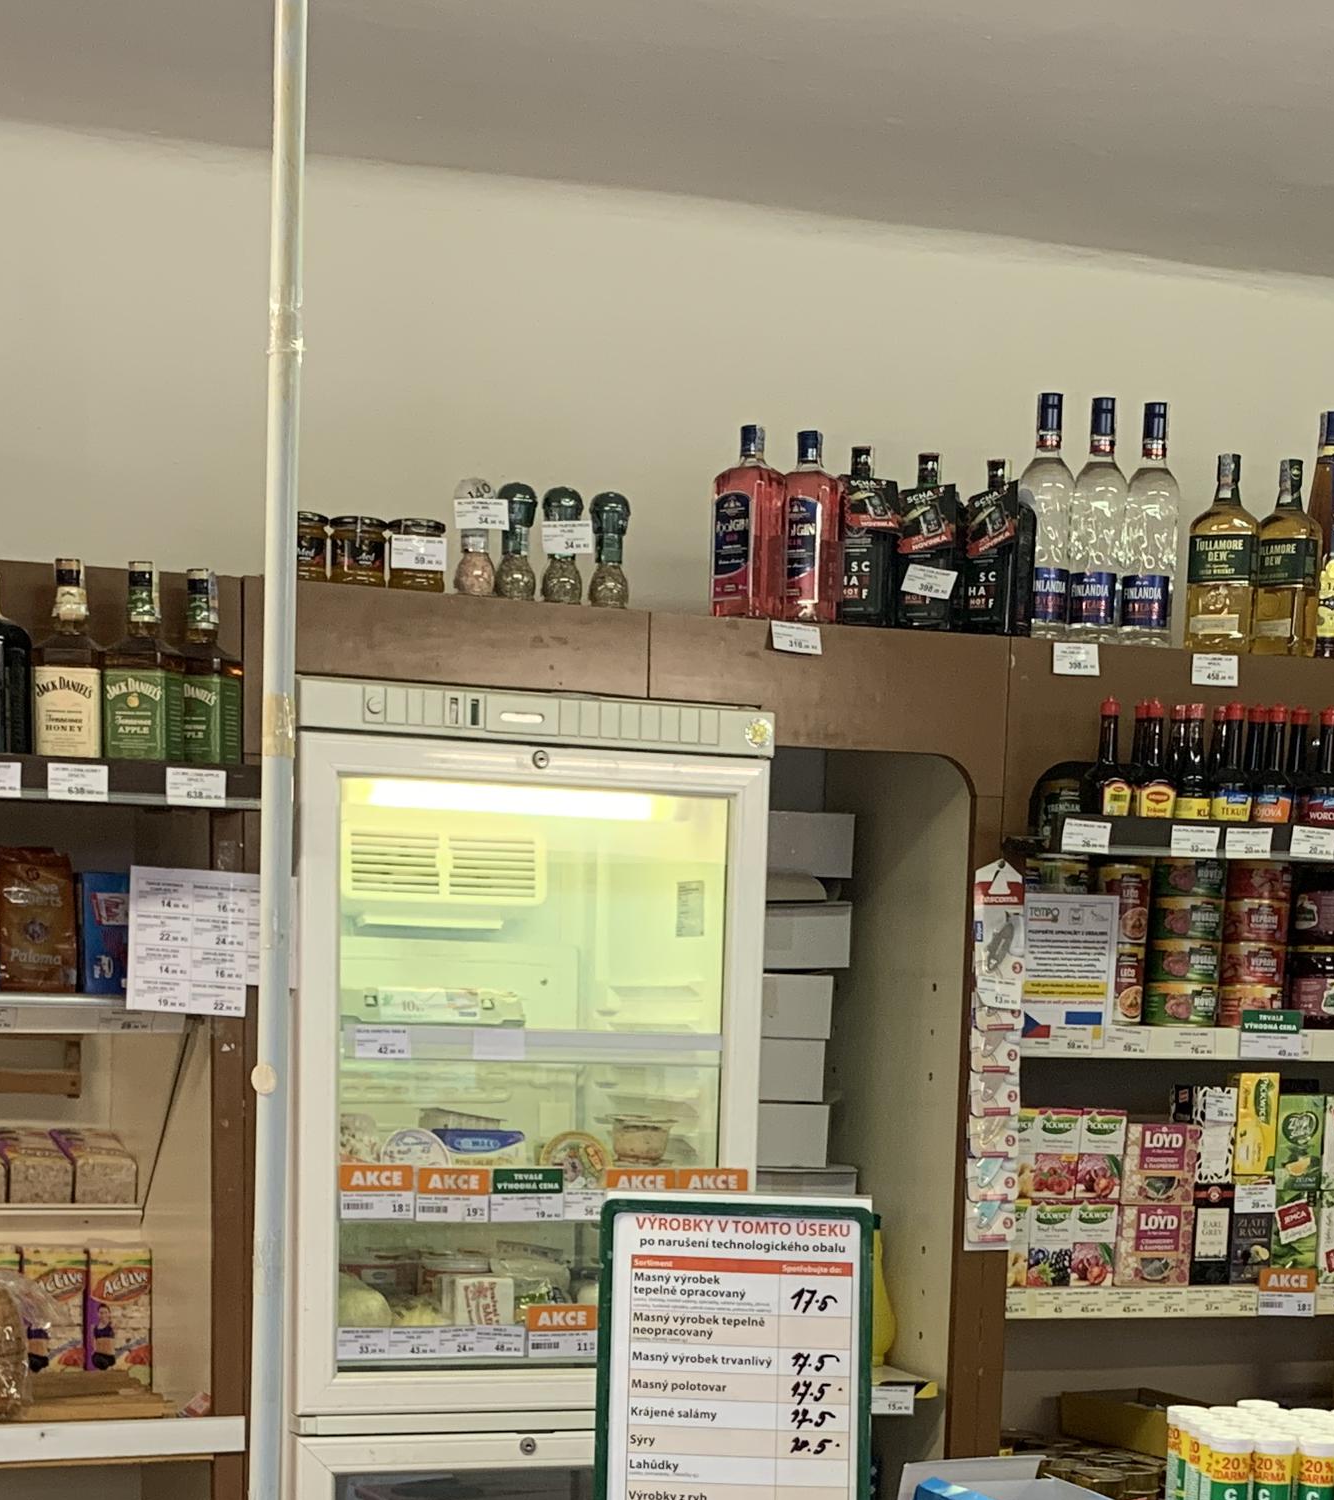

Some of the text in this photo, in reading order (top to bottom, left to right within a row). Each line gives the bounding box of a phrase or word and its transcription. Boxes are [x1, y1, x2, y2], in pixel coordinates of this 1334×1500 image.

[1196, 538, 1244, 551] TULLAMORE
[1207, 551, 1227, 561] DEW
[1123, 584, 1162, 600] FINLANDIA
[36, 677, 58, 698] JACK
[106, 679, 127, 700] JACK
[45, 724, 84, 733] HONEY
[117, 724, 150, 734] APPLE
[1144, 1130, 1183, 1149] LOYD
[350, 1171, 403, 1187] AKCE
[536, 1181, 559, 1191] CENA
[635, 1214, 851, 1237] VÝROBKY V TOMTO ÚSEKU
[1140, 1212, 1178, 1231] LOYD
[640, 1237, 846, 1253] po narušení technologického obalu
[102, 1267, 149, 1298] Active
[634, 1272, 720, 1285] Masný výrobek
[634, 1285, 746, 1300] tepelně opracovaný
[633, 1312, 766, 1329] Masný výrobek tepelně
[632, 1326, 713, 1339] neopracovaný
[632, 1351, 773, 1368] Masný výrobek trvanlivý
[632, 1379, 727, 1393] Masný polotovar
[631, 1407, 717, 1421] Krájené salámy
[630, 1434, 655, 1447] Sýry
[629, 1459, 679, 1473] Lahůdky
